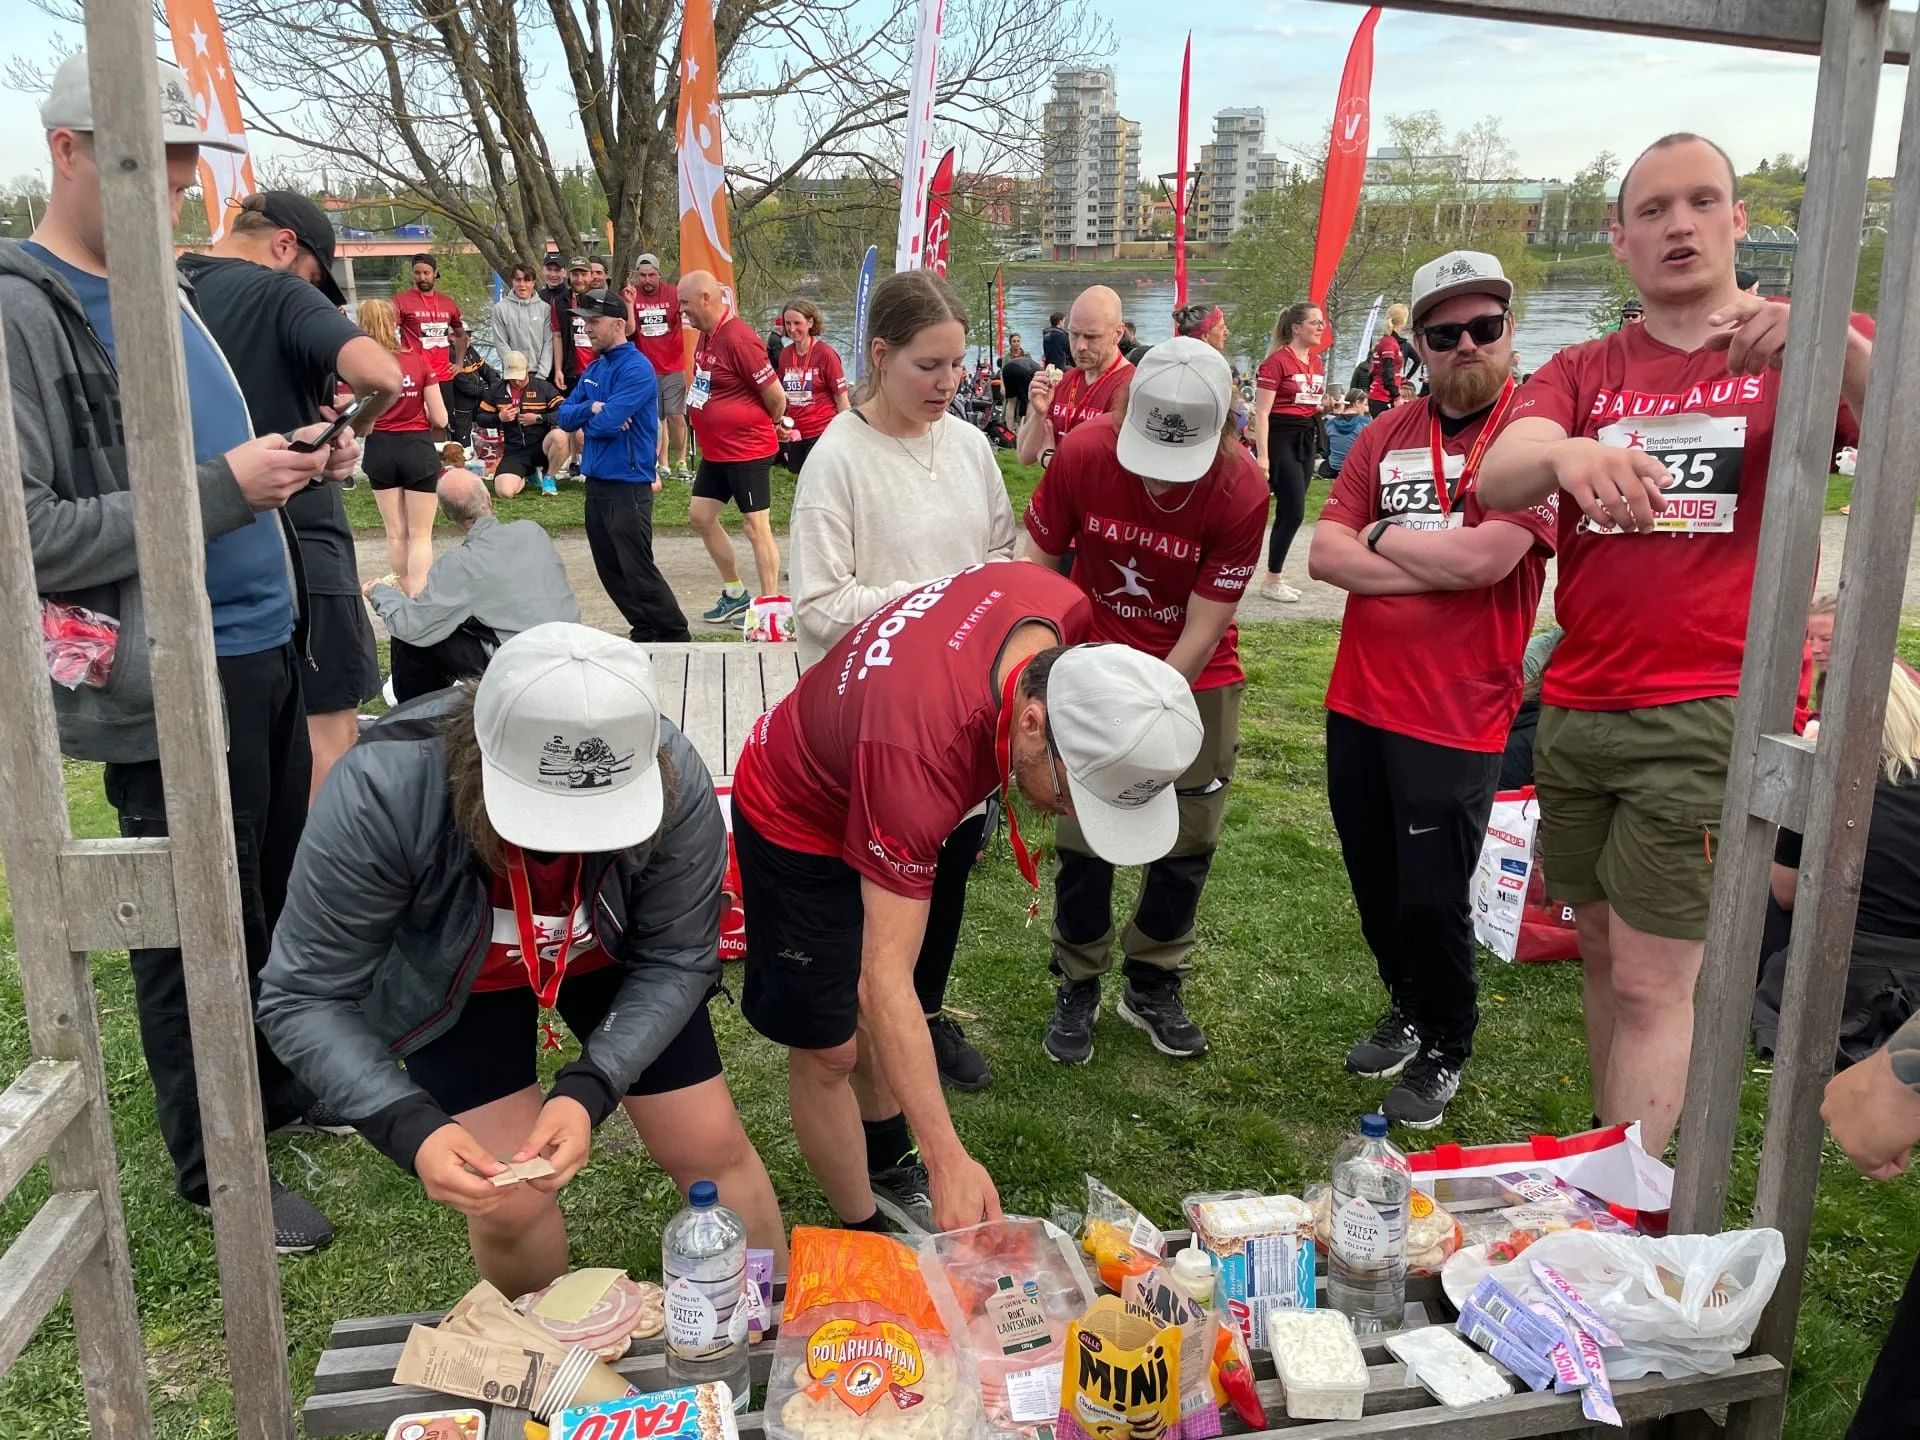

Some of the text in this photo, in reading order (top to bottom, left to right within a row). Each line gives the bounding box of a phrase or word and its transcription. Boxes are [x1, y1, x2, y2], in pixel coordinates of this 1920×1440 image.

[643, 315, 663, 324] 4629
[1646, 436, 1703, 446] Blodomloppet
[947, 589, 1003, 651] BAUHAUS
[838, 650, 857, 696] lopp
[1561, 907, 1576, 922] B
[1523, 1184, 1555, 1202] FOLKE
[1343, 1220, 1379, 1235] GUTTSTA
[669, 1304, 704, 1318] GUTTSTA
[997, 1313, 1045, 1335] LANTSKINKA
[1080, 1332, 1102, 1350] GILLE
[812, 1338, 918, 1375] POLARHJÄRTAN
[571, 1399, 691, 1440] FALU
